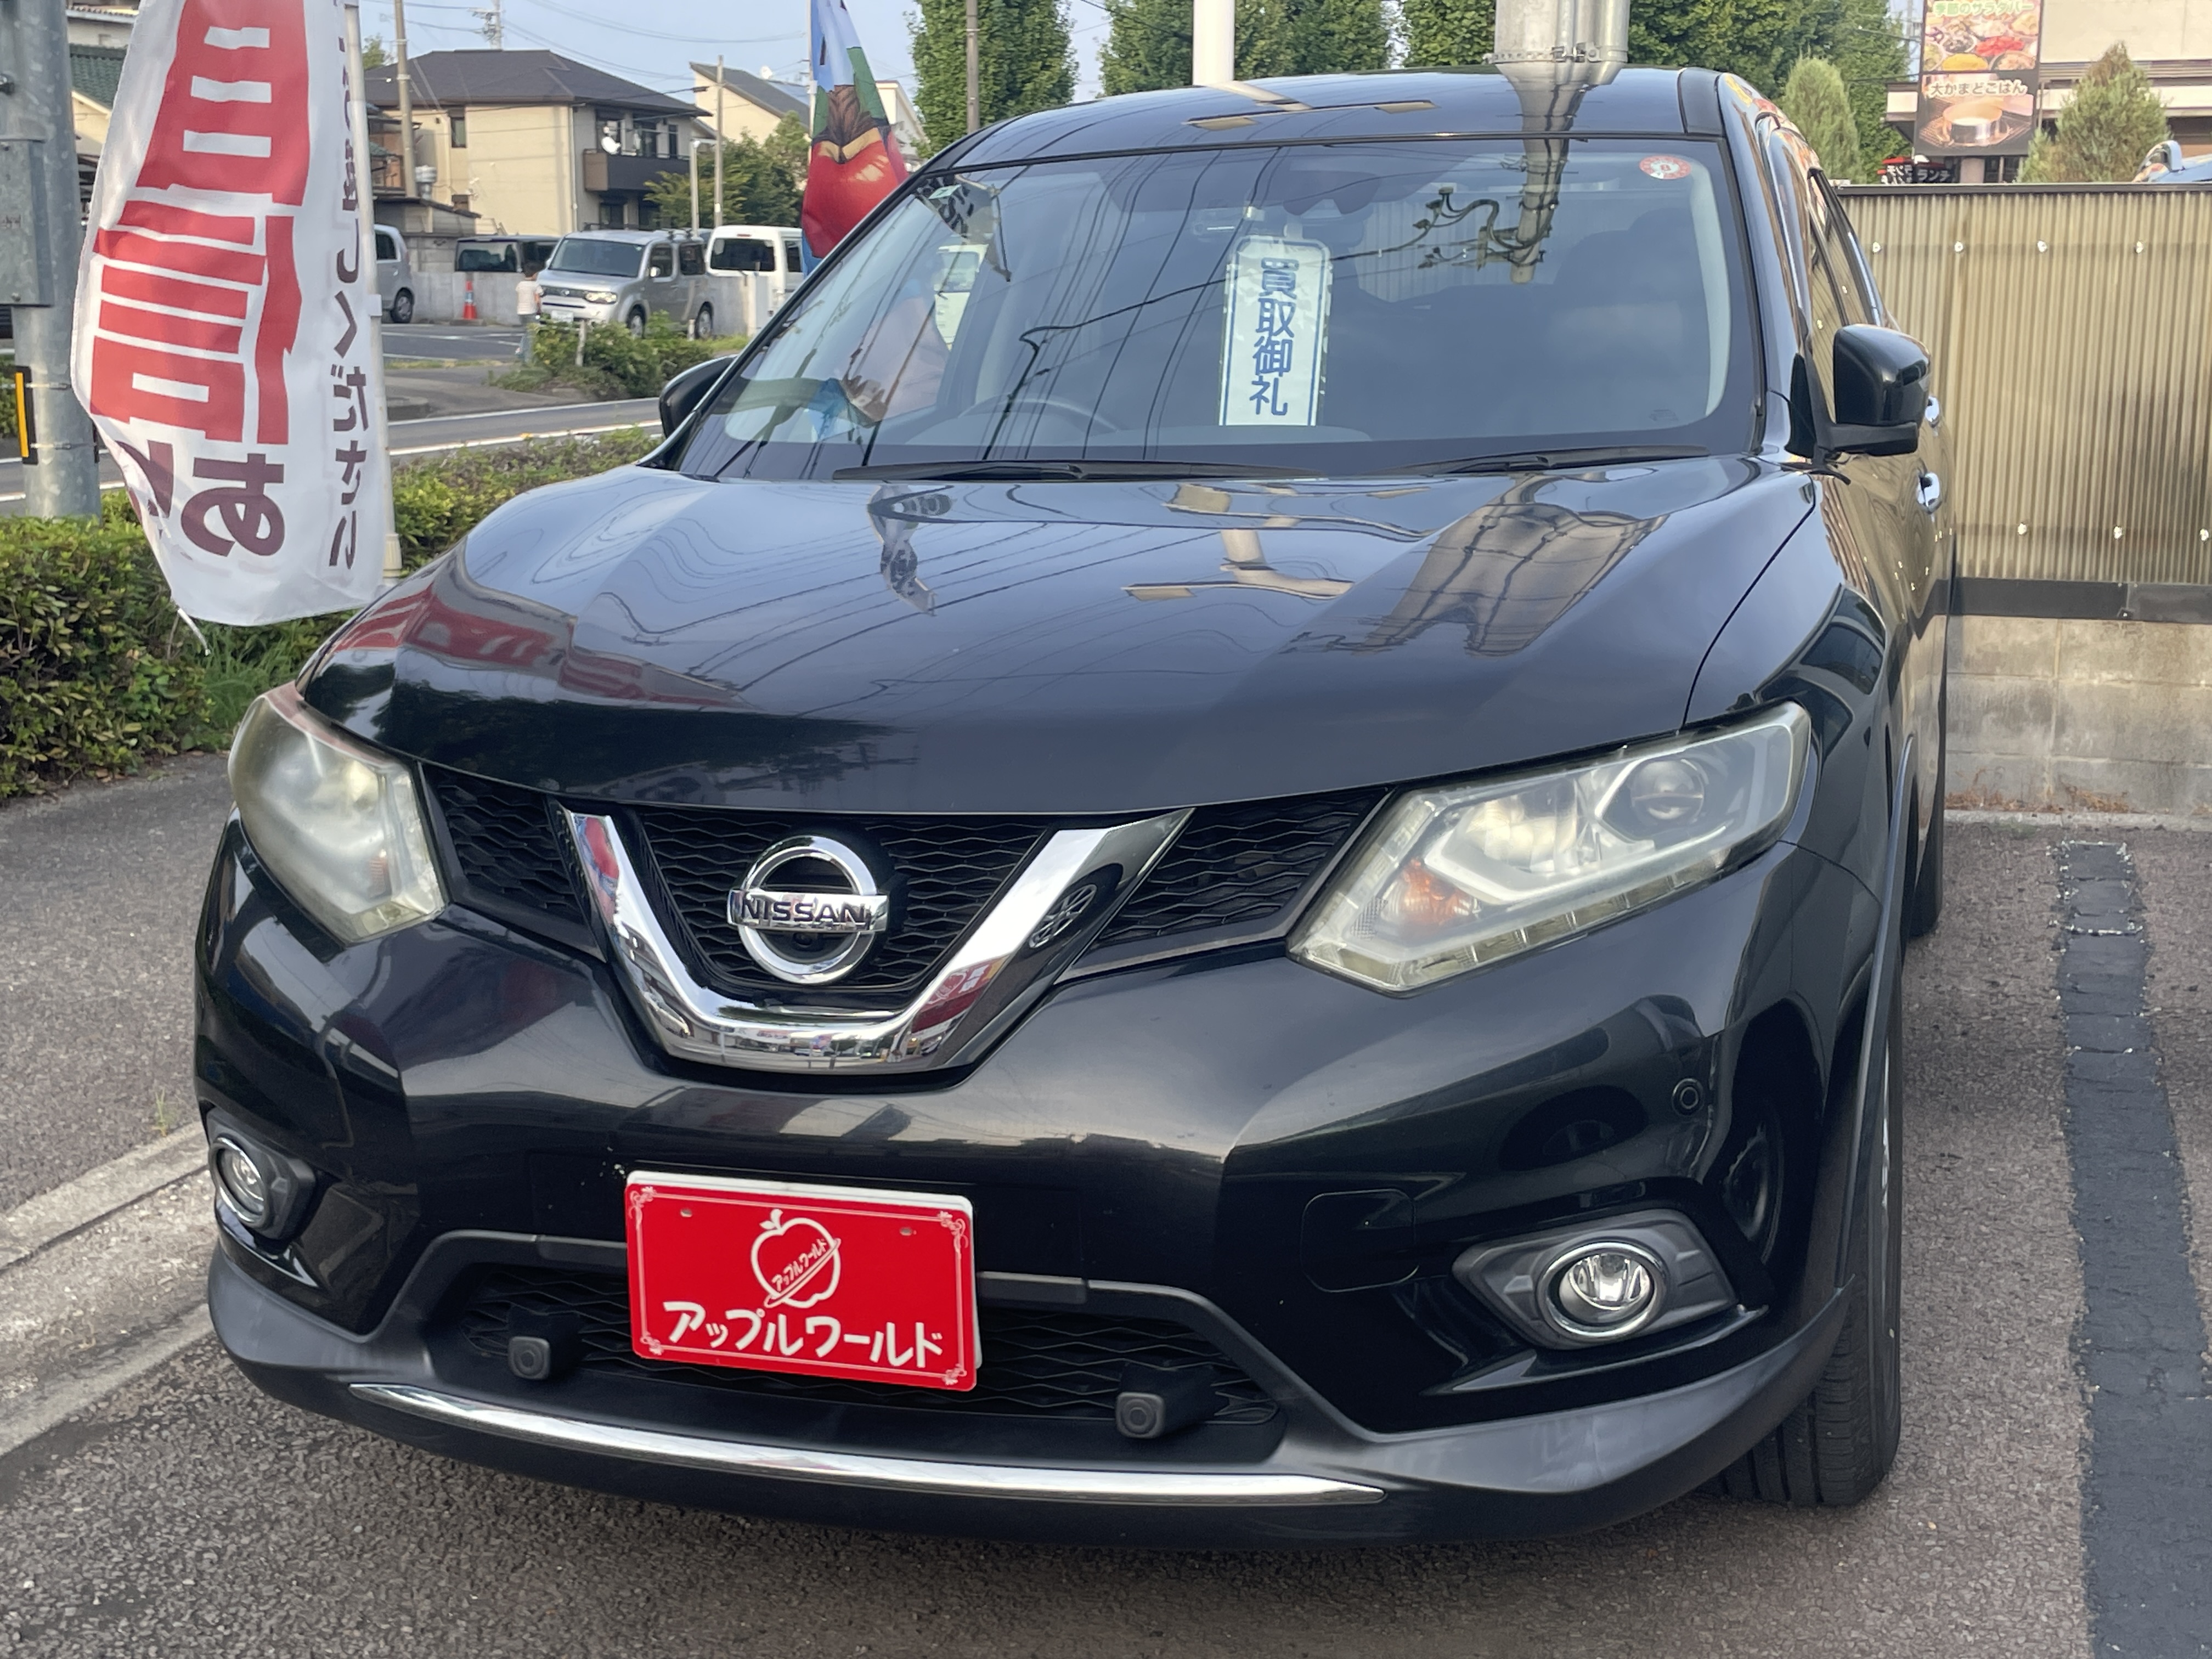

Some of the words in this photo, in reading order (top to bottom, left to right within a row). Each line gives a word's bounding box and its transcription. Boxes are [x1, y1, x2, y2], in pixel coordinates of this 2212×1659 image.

[1249, 257, 1300, 416] 買取御礼
[741, 894, 868, 924] NISSAN
[771, 1238, 827, 1292] アップルワールド
[663, 1301, 943, 1368] アップルワールド
